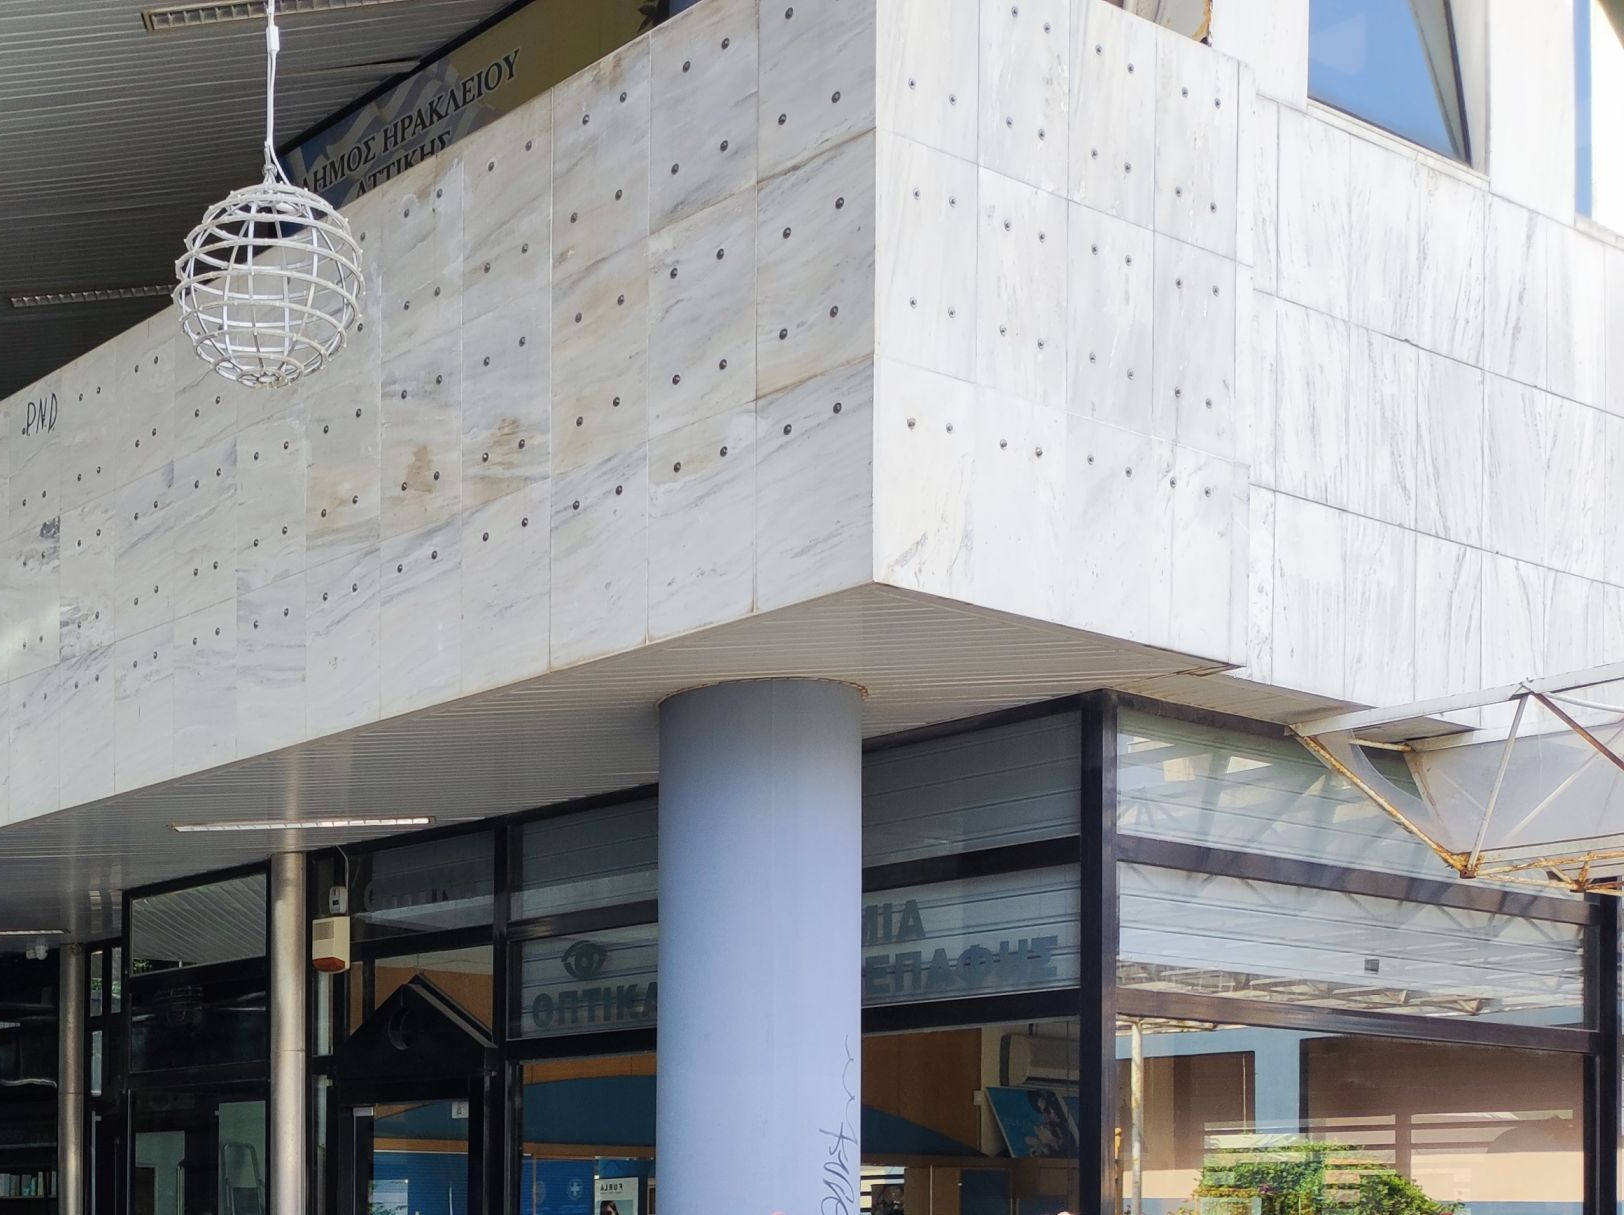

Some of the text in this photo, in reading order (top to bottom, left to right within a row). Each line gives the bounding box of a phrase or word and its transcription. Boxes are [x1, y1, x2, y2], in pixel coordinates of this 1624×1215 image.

[382, 48, 520, 154] ΗΡΑΚΛΕΙΟΥ
[356, 130, 451, 198] ΑΤΤΙΚΗΣ
[865, 936, 1058, 994] ΕΠΑΦΗΣ
